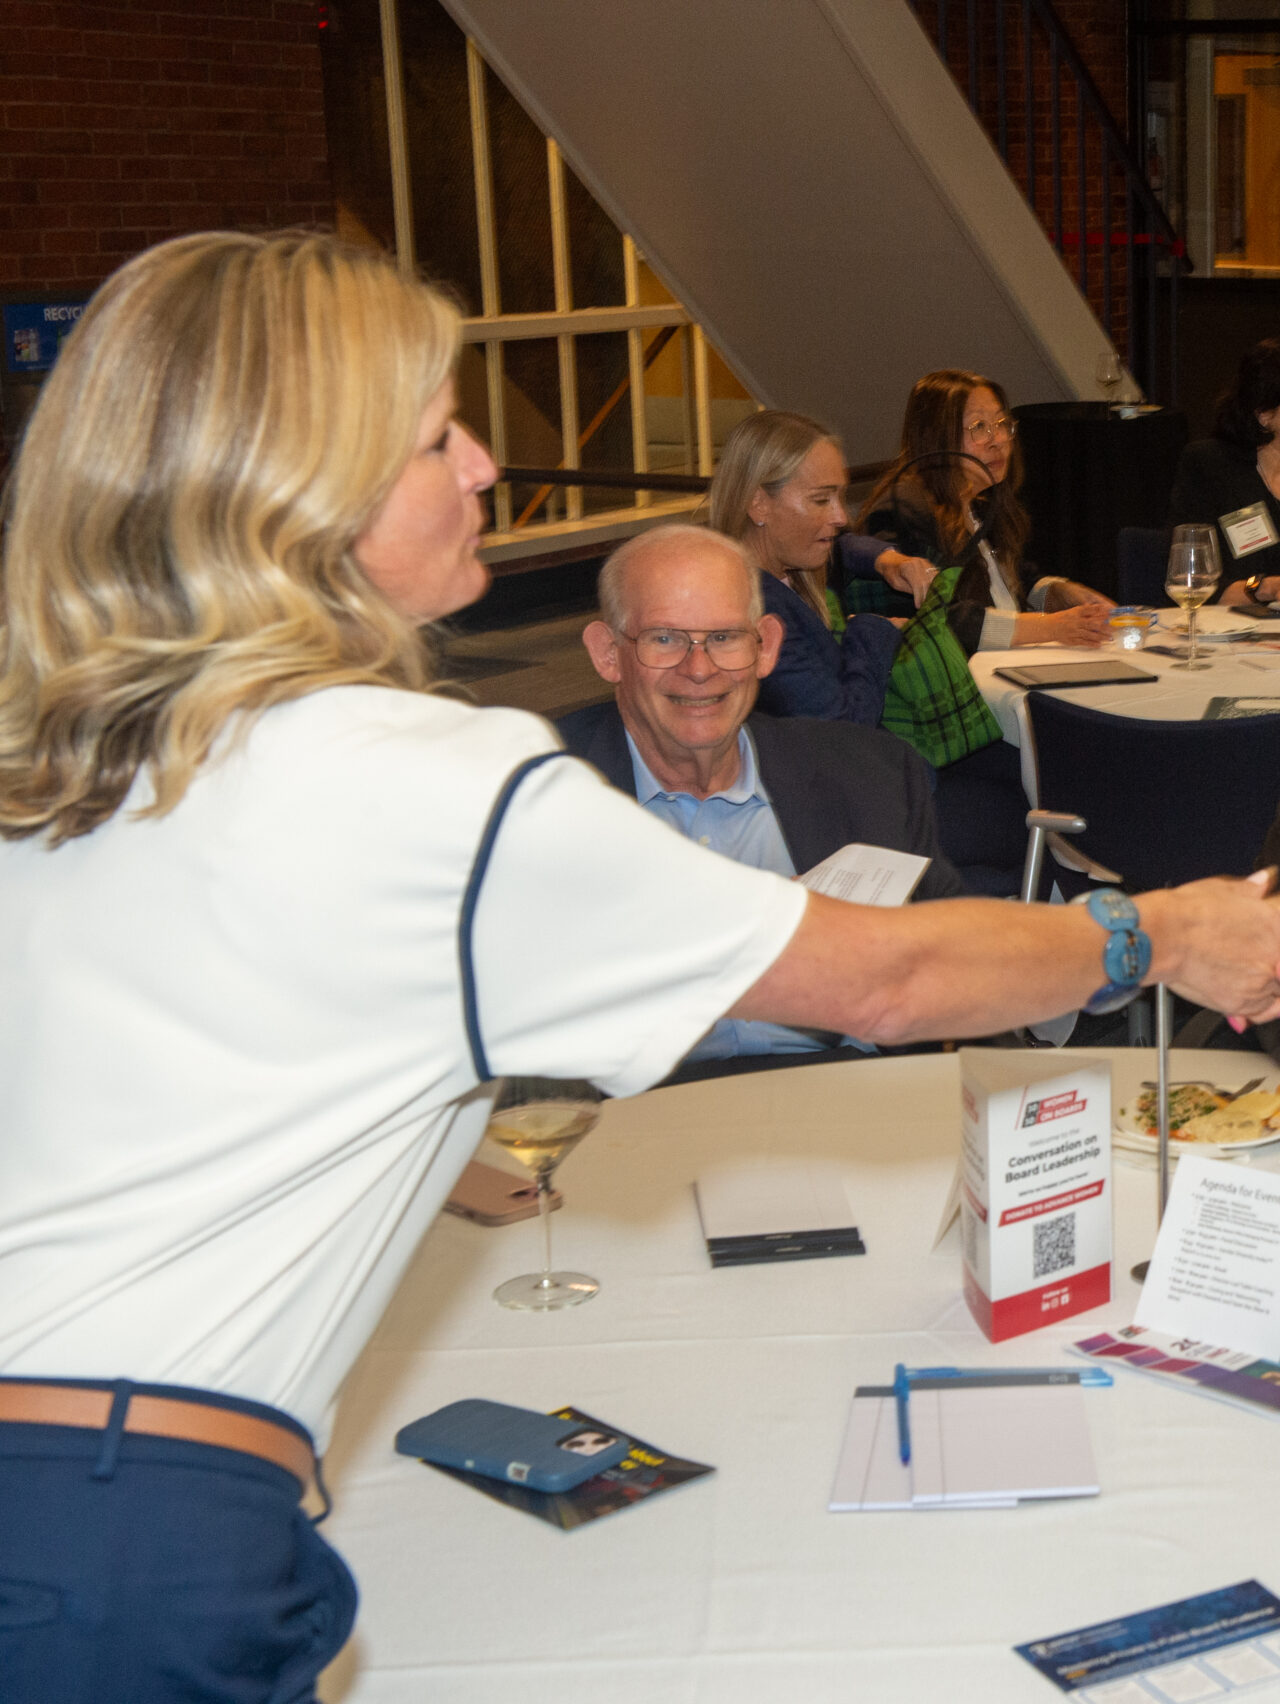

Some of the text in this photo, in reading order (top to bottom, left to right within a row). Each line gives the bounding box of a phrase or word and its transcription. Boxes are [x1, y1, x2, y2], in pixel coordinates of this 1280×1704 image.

[1005, 1145, 1101, 1183] Board Leadership
[1008, 1134, 1098, 1168] Conversation on
[1200, 1178, 1237, 1195] Agenda
[1239, 1184, 1254, 1198] for
